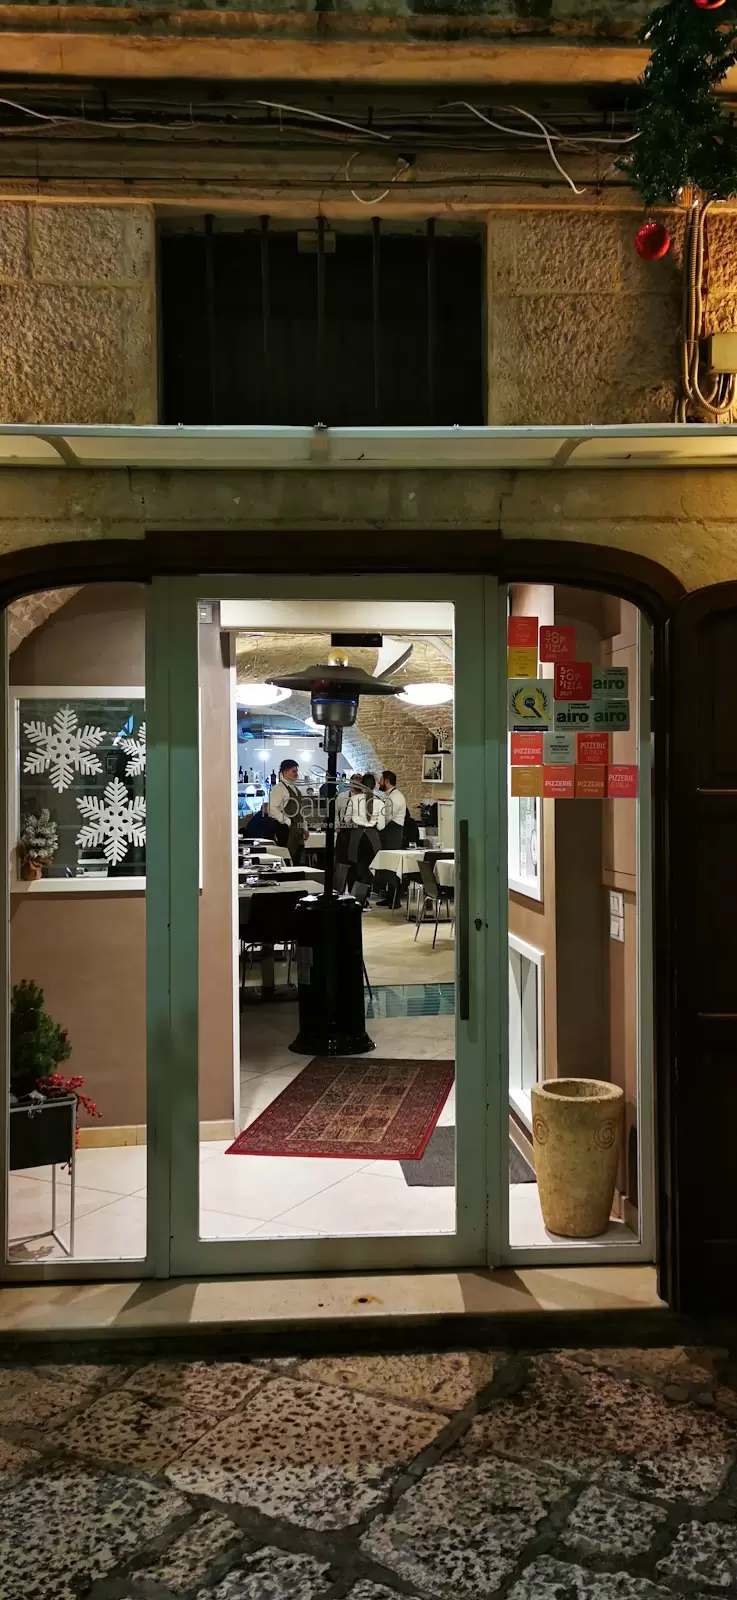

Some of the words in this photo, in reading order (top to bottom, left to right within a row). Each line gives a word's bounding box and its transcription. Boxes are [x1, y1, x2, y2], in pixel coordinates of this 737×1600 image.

[593, 677, 625, 689] airo
[557, 710, 589, 722] airo
[594, 710, 627, 722] airo
[580, 741, 607, 749] PIZZERIE
[608, 774, 635, 782] PIZZERIE
